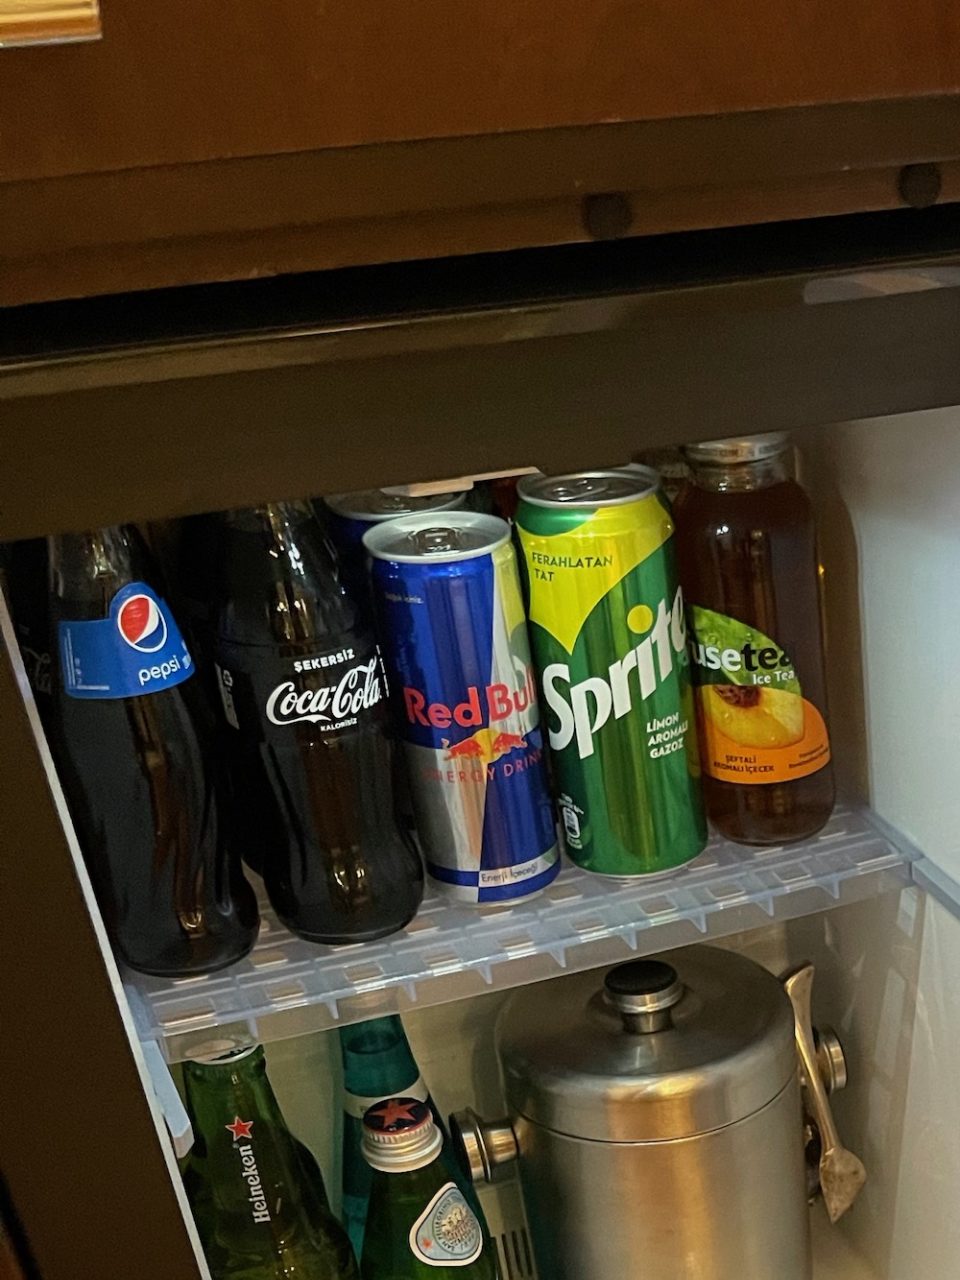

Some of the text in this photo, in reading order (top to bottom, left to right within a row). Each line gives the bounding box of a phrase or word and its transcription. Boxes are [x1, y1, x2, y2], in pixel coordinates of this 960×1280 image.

[531, 552, 613, 568] FERAHLATAN
[534, 568, 555, 582] TAT
[138, 654, 182, 687] pepsi
[293, 648, 356, 674] ŞEKERSİZ
[542, 585, 687, 760] Sprite
[265, 655, 383, 726] Coca-Cola
[752, 670, 795, 685] Ice Tea
[403, 685, 483, 728] Red
[646, 712, 680, 733] LİMON
[650, 737, 684, 759] GAZOZ
[238, 1143, 272, 1224] Heineken
